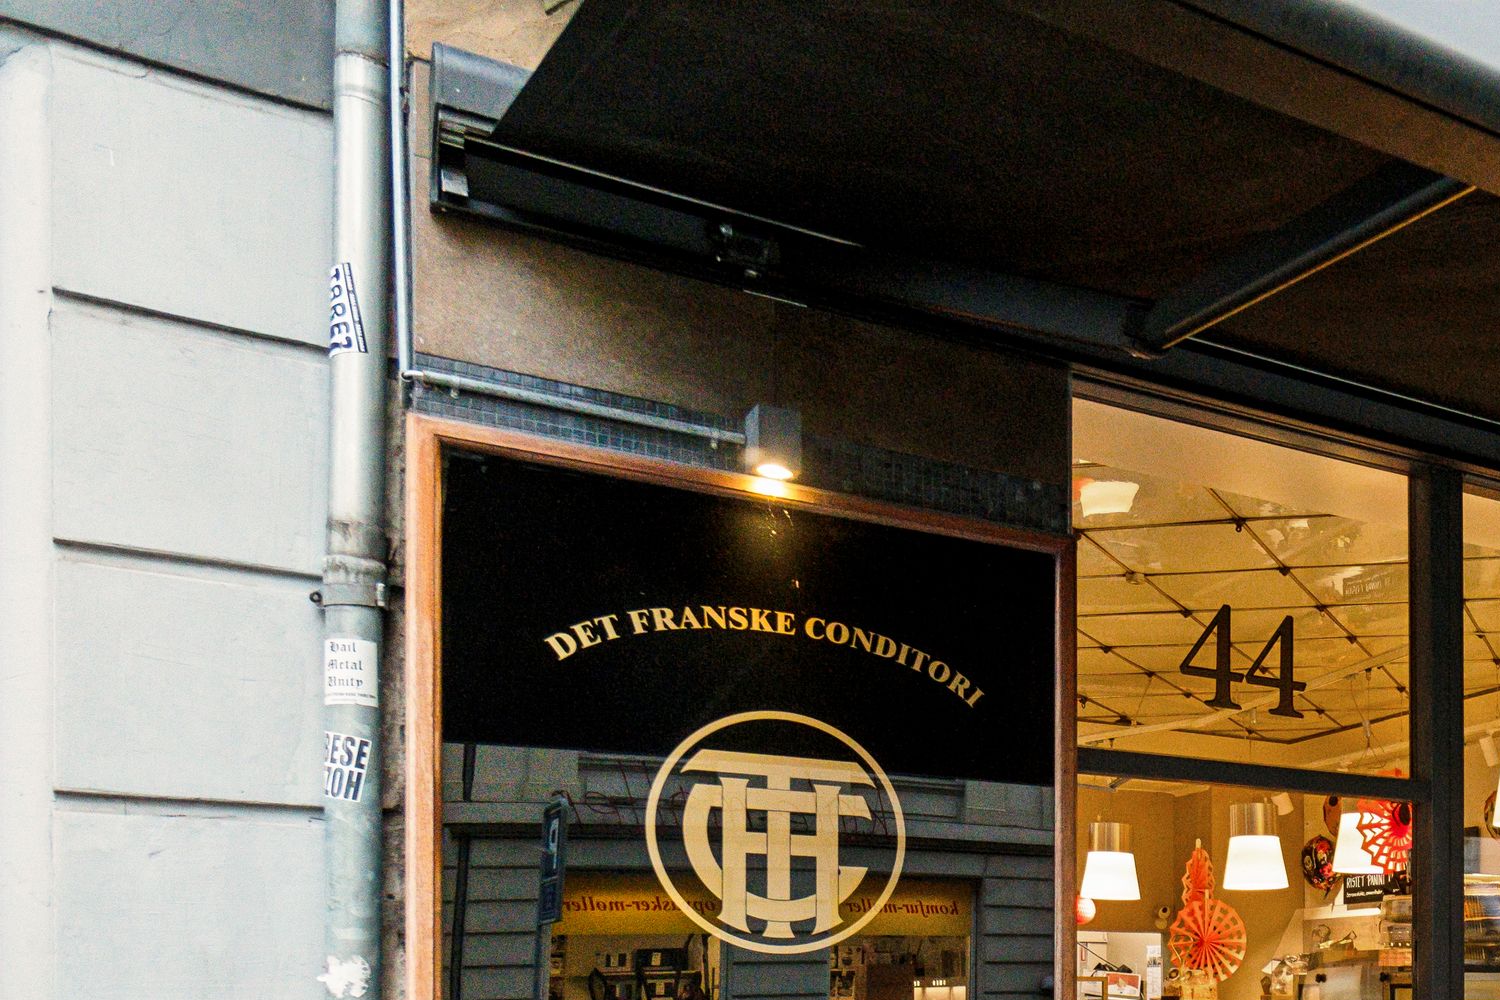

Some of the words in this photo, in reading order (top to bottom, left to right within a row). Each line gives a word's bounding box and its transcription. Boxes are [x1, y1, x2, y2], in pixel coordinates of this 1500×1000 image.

[327, 659, 364, 671] Metal
[544, 613, 619, 661] DET
[628, 605, 796, 636] FRANSKE
[804, 617, 986, 709] CONDITORI
[1179, 604, 1307, 719] 44
